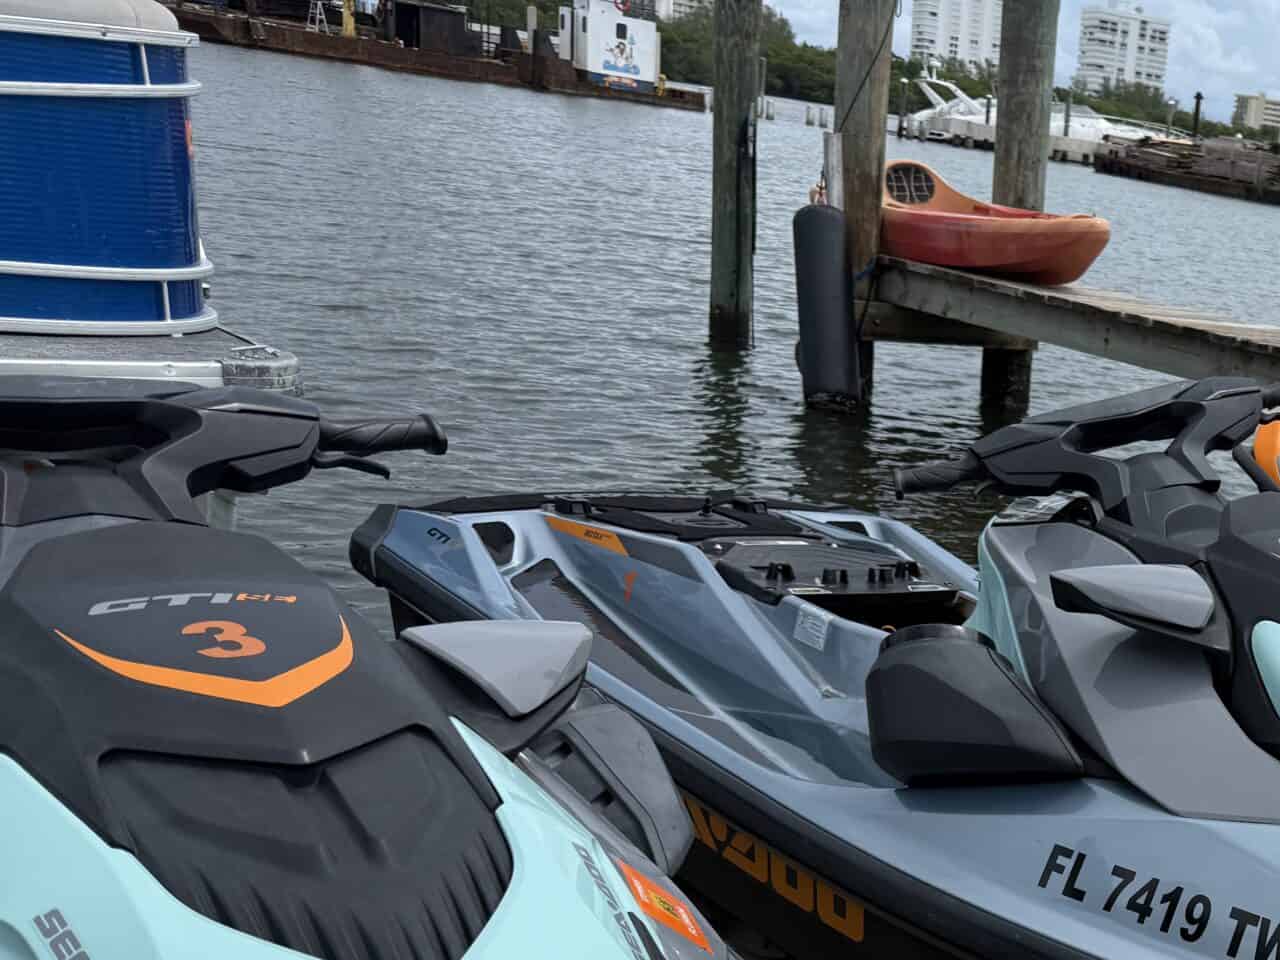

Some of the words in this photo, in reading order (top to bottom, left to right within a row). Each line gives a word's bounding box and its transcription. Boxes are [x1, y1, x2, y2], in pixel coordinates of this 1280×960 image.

[426, 527, 451, 544] GTI
[87, 592, 233, 616] GTI
[180, 619, 267, 659] 3
[1038, 843, 1087, 902] FL
[1102, 864, 1212, 943] 7419
